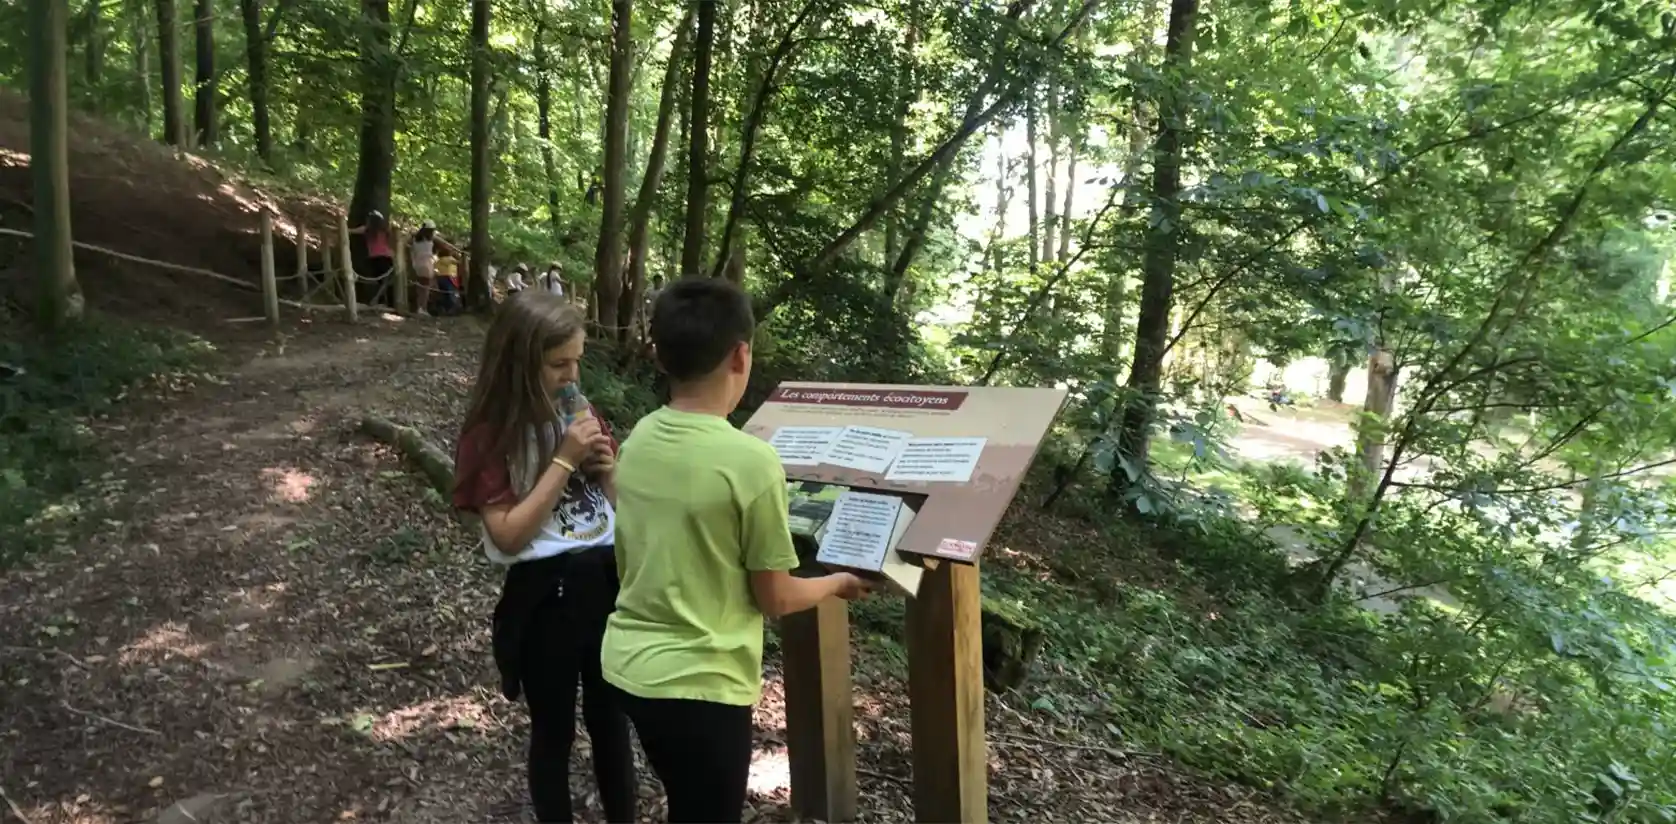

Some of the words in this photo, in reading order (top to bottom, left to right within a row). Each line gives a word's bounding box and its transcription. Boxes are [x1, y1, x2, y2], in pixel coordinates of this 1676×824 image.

[780, 388, 799, 399] Les
[801, 389, 880, 403] comportements
[883, 391, 949, 406] écocitoyens
